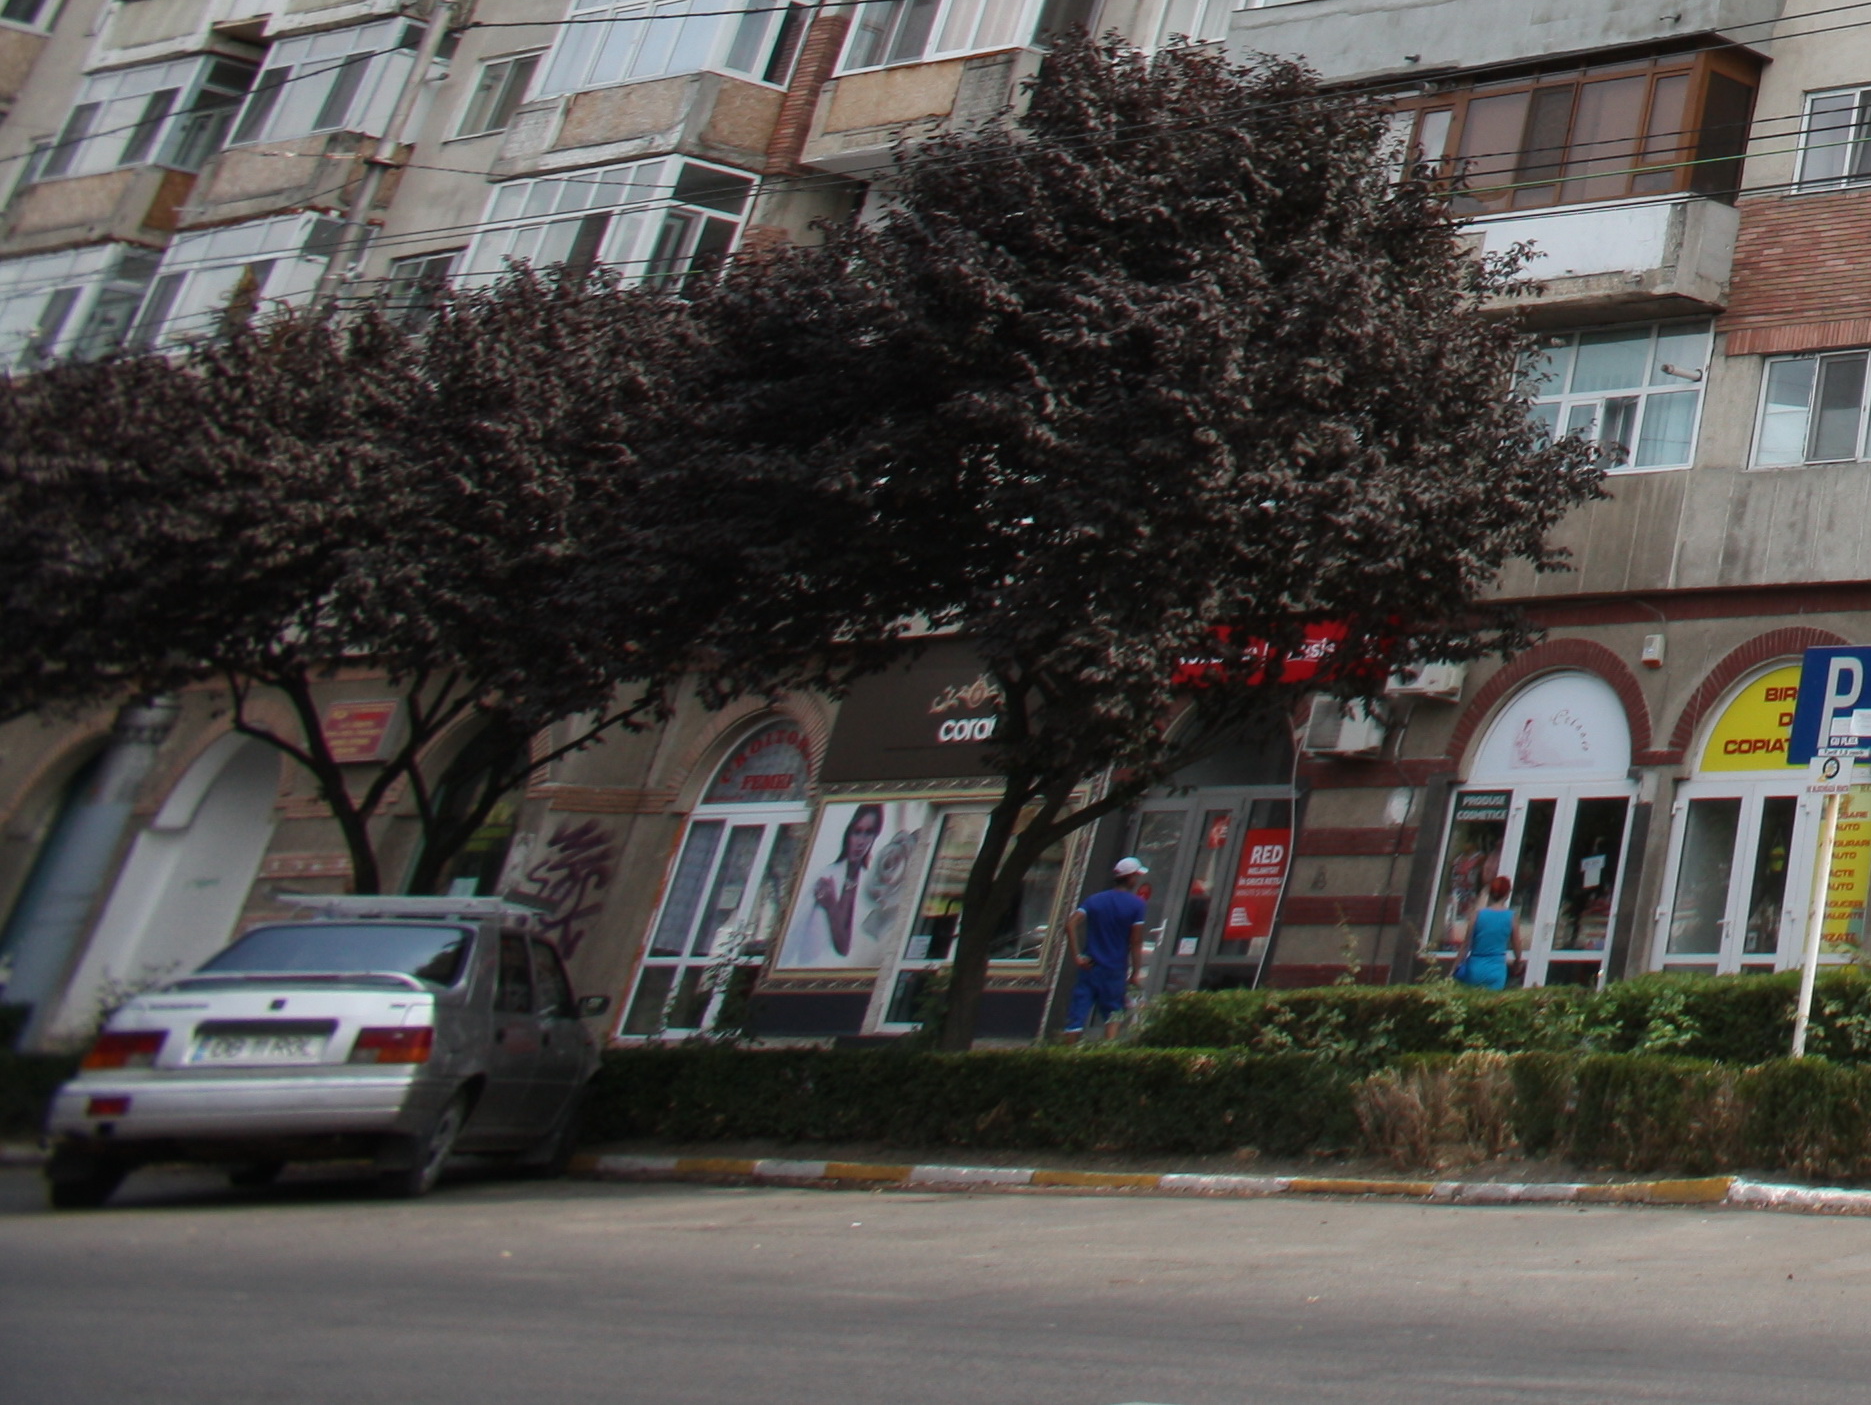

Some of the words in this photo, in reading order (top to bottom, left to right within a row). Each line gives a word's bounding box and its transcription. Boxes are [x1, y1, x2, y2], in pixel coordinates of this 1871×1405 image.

[1816, 656, 1864, 749] P
[1723, 738, 1791, 756] COPIA
[1249, 844, 1285, 865] RED
